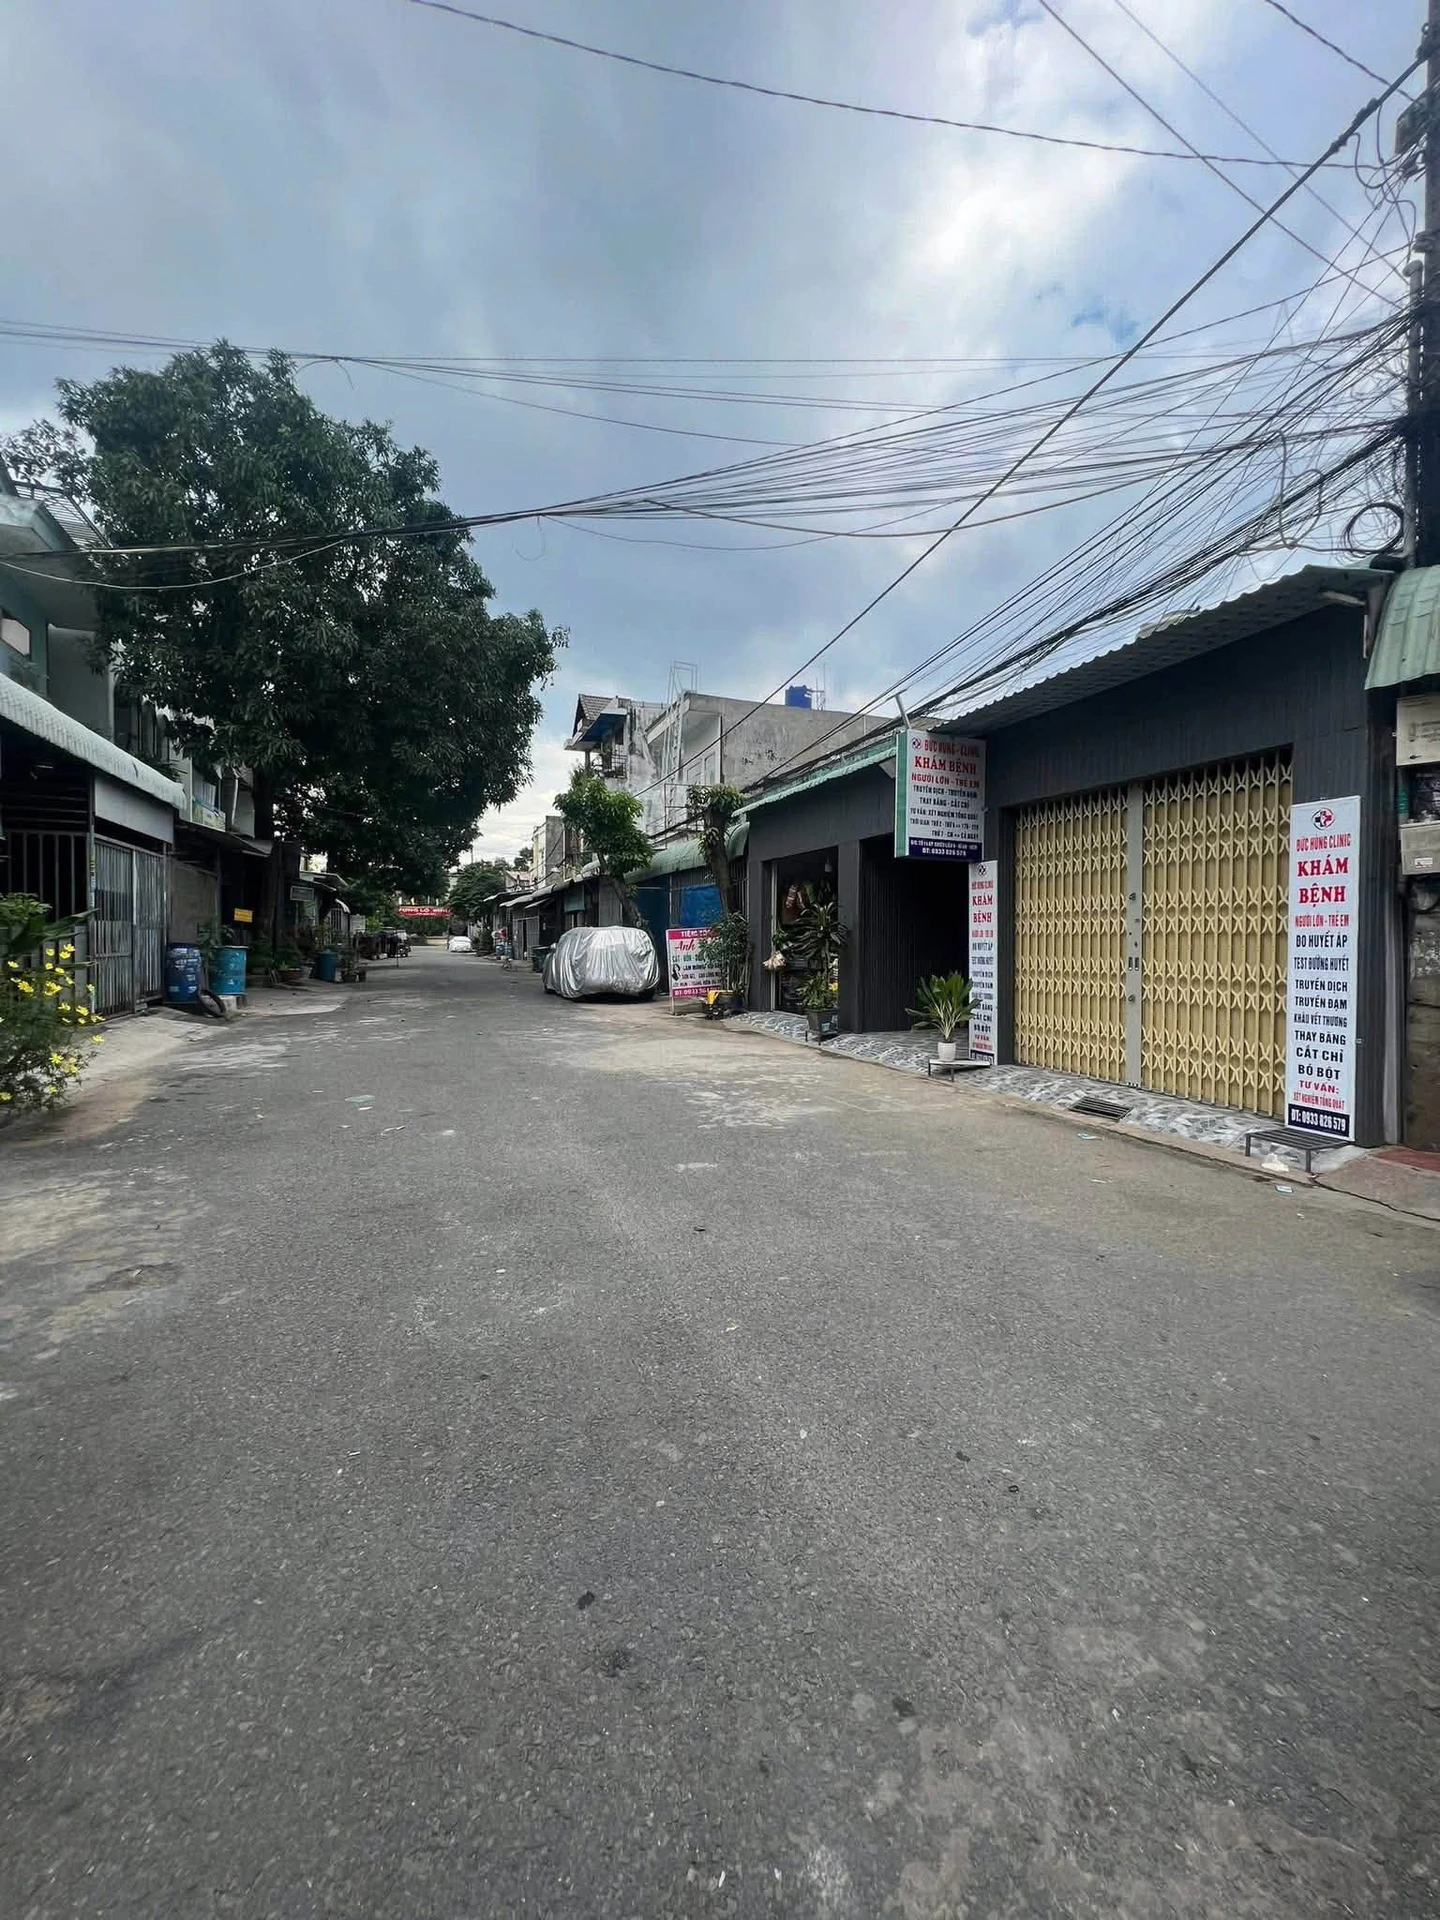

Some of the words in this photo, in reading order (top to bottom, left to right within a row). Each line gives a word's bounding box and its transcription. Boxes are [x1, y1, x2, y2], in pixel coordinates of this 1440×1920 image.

[915, 755, 946, 771] KHÁM
[949, 758, 976, 776] BỆNH
[1329, 832, 1351, 849] CLINIC
[1297, 854, 1349, 877] KHÁM
[1299, 882, 1346, 908] BỆNH
[1296, 934, 1307, 948] ĐO
[1308, 930, 1334, 948] HUYẾT
[1336, 931, 1348, 948] ÁP
[1294, 956, 1307, 970] TEST
[1330, 954, 1349, 971] HUYẾT
[1327, 980, 1348, 994] DỊCH
[1328, 998, 1347, 1012] ĐẠM
[1295, 1029, 1317, 1042] THAY
[1319, 1031, 1346, 1046] BĂNG
[1296, 1044, 1318, 1059] CẮT
[1322, 1049, 1343, 1063] CHỈ
[1298, 1063, 1313, 1076] BÓ
[1317, 1066, 1341, 1081] BỘT
[1300, 1080, 1312, 1089] TƯ
[1314, 1081, 1339, 1094] VẤN:
[1302, 1110, 1318, 1126] 0933
[1333, 1116, 1346, 1132] 579
